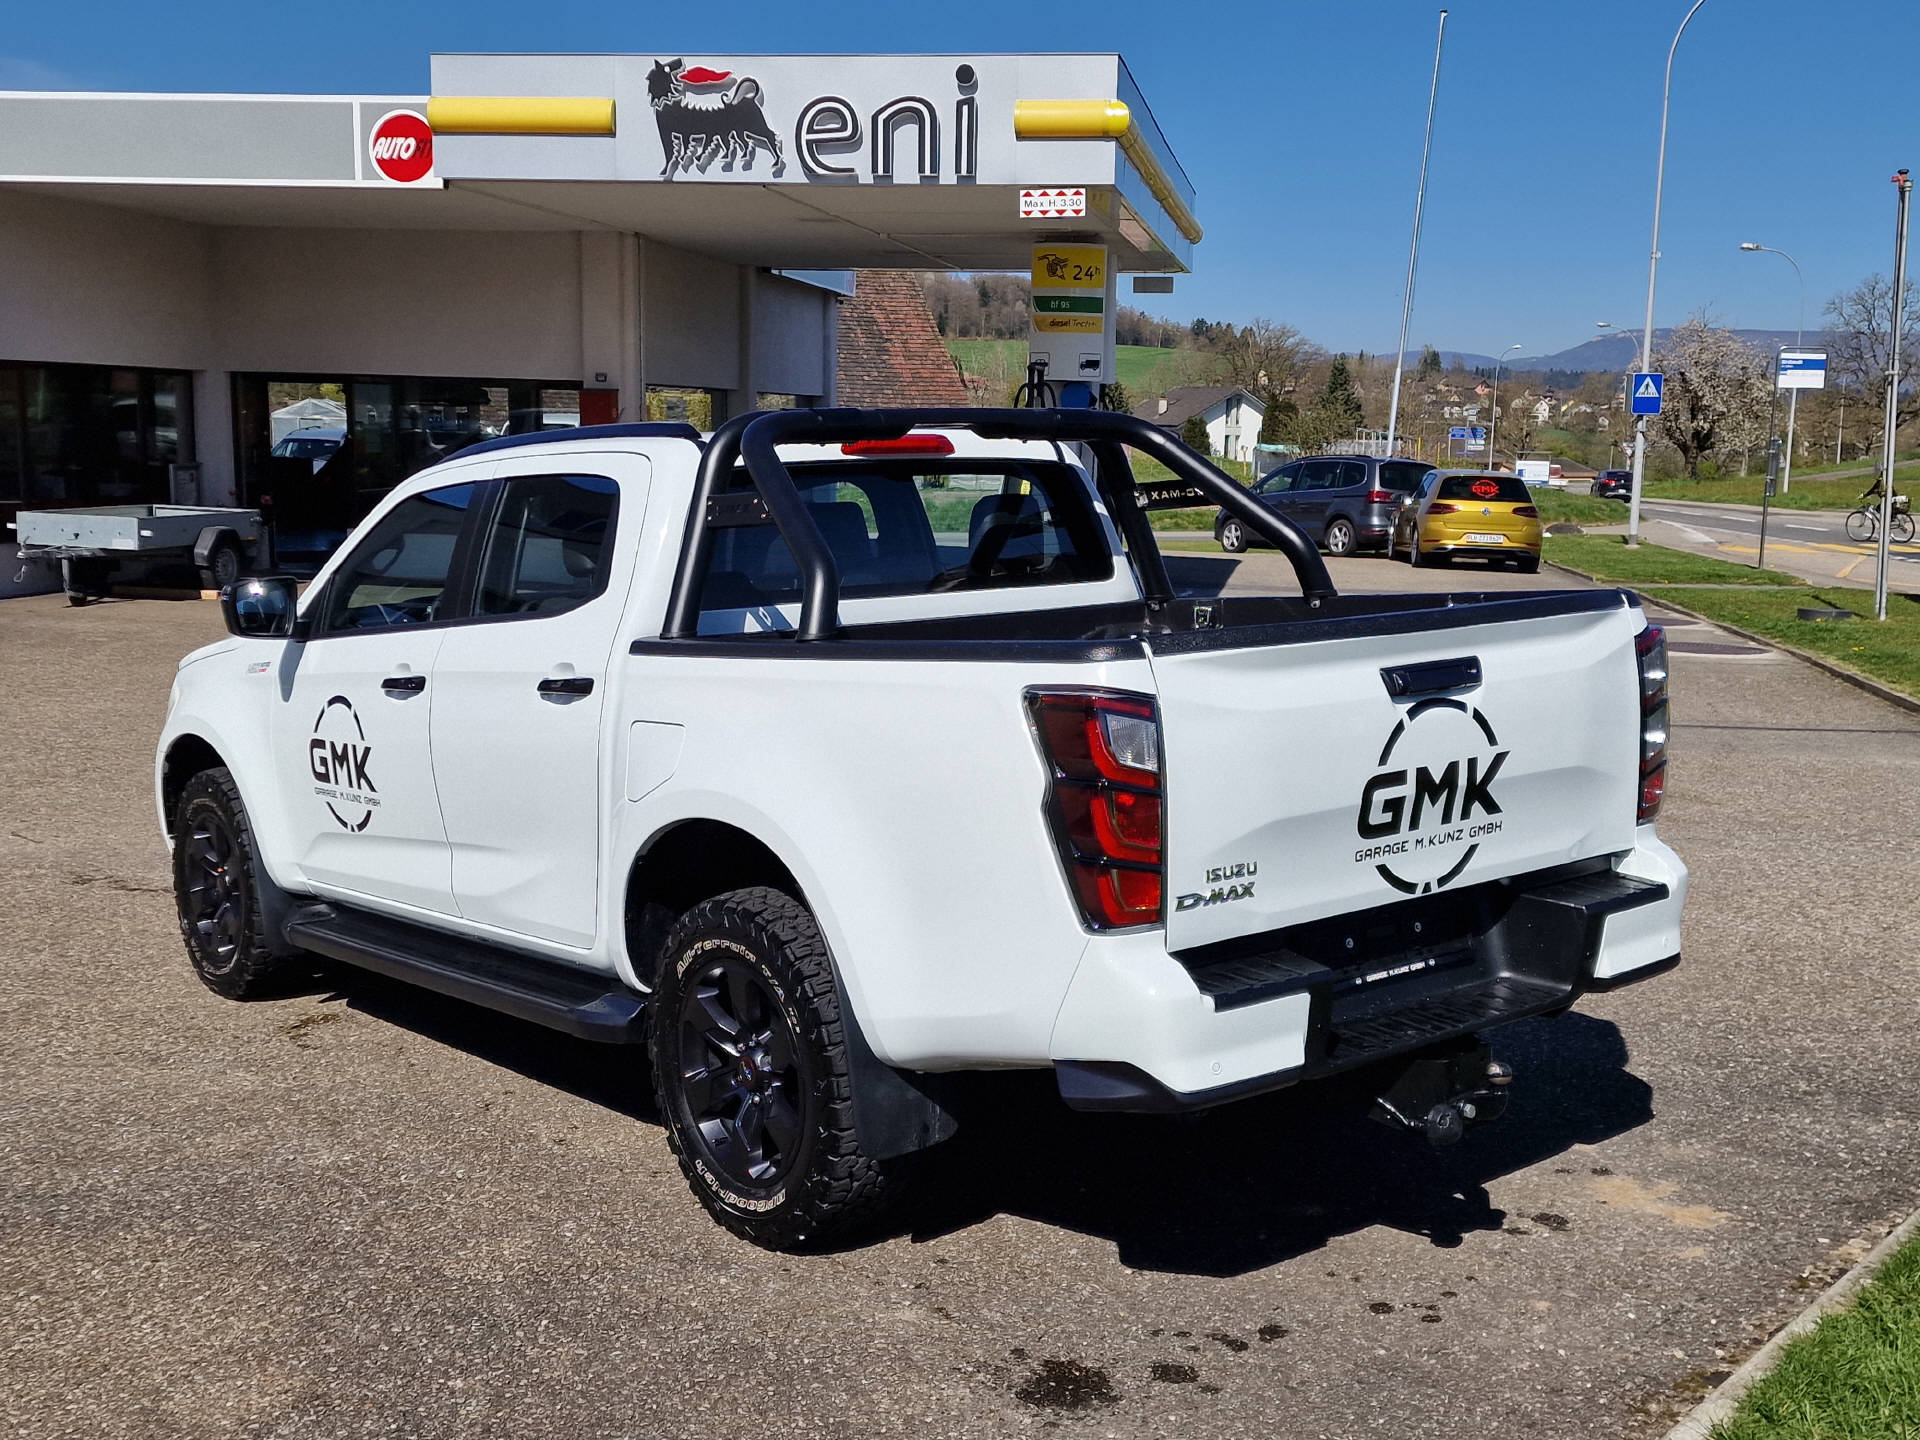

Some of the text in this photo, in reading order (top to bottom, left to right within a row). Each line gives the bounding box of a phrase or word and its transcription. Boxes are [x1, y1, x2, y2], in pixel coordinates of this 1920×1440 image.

[795, 64, 976, 176] eni
[1024, 199, 1044, 208] Max
[1060, 198, 1082, 207] 3.30
[1072, 265, 1101, 281] 24h
[1472, 485, 1500, 494] GMK
[309, 738, 378, 793] GMK
[1357, 750, 1511, 840] GMK
[1354, 821, 1503, 863] GARAGE M.KUNZ GMBH
[1206, 861, 1258, 884] ISUZU
[1174, 881, 1256, 913] D-MAX
